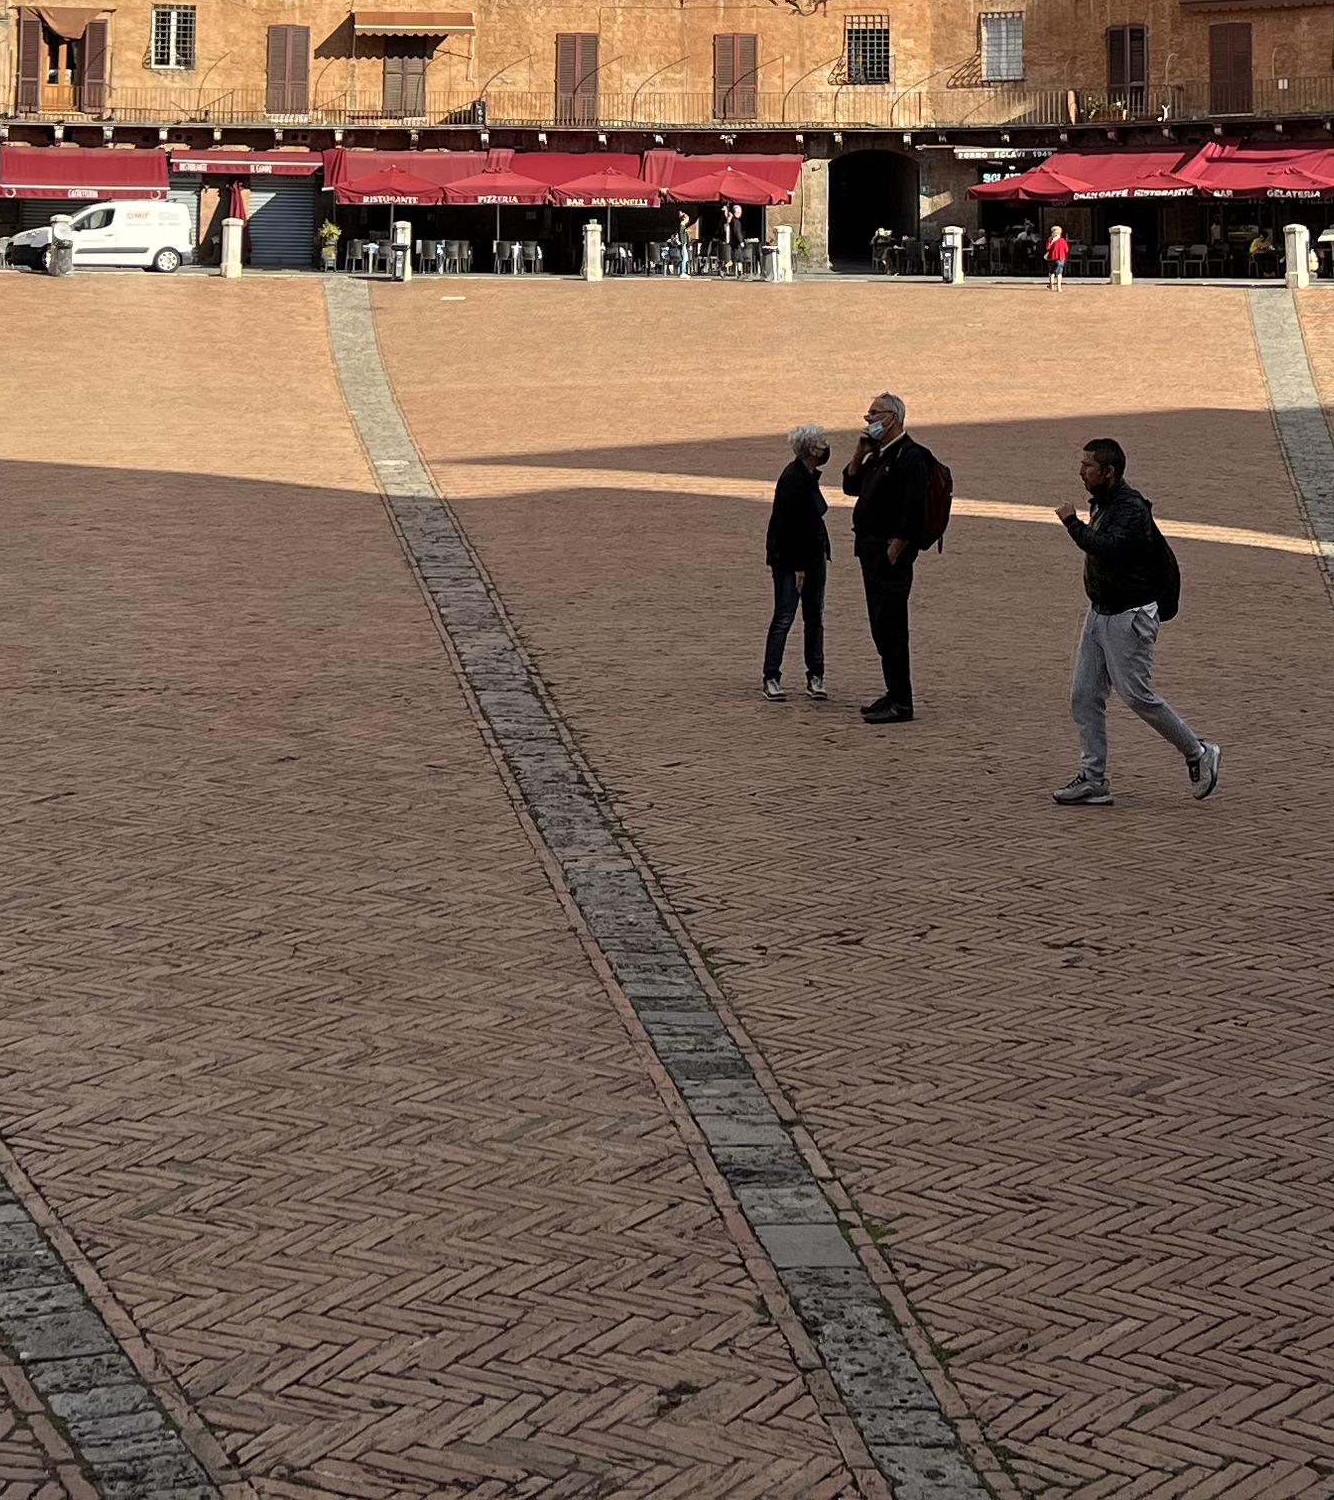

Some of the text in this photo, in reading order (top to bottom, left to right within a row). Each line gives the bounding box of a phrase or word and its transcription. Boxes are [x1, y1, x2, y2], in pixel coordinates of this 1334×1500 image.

[1266, 189, 1321, 198] GELATERIA
[363, 195, 419, 204] RISTORANTE
[478, 194, 519, 203] PIZZERIA
[567, 198, 585, 206] BAR
